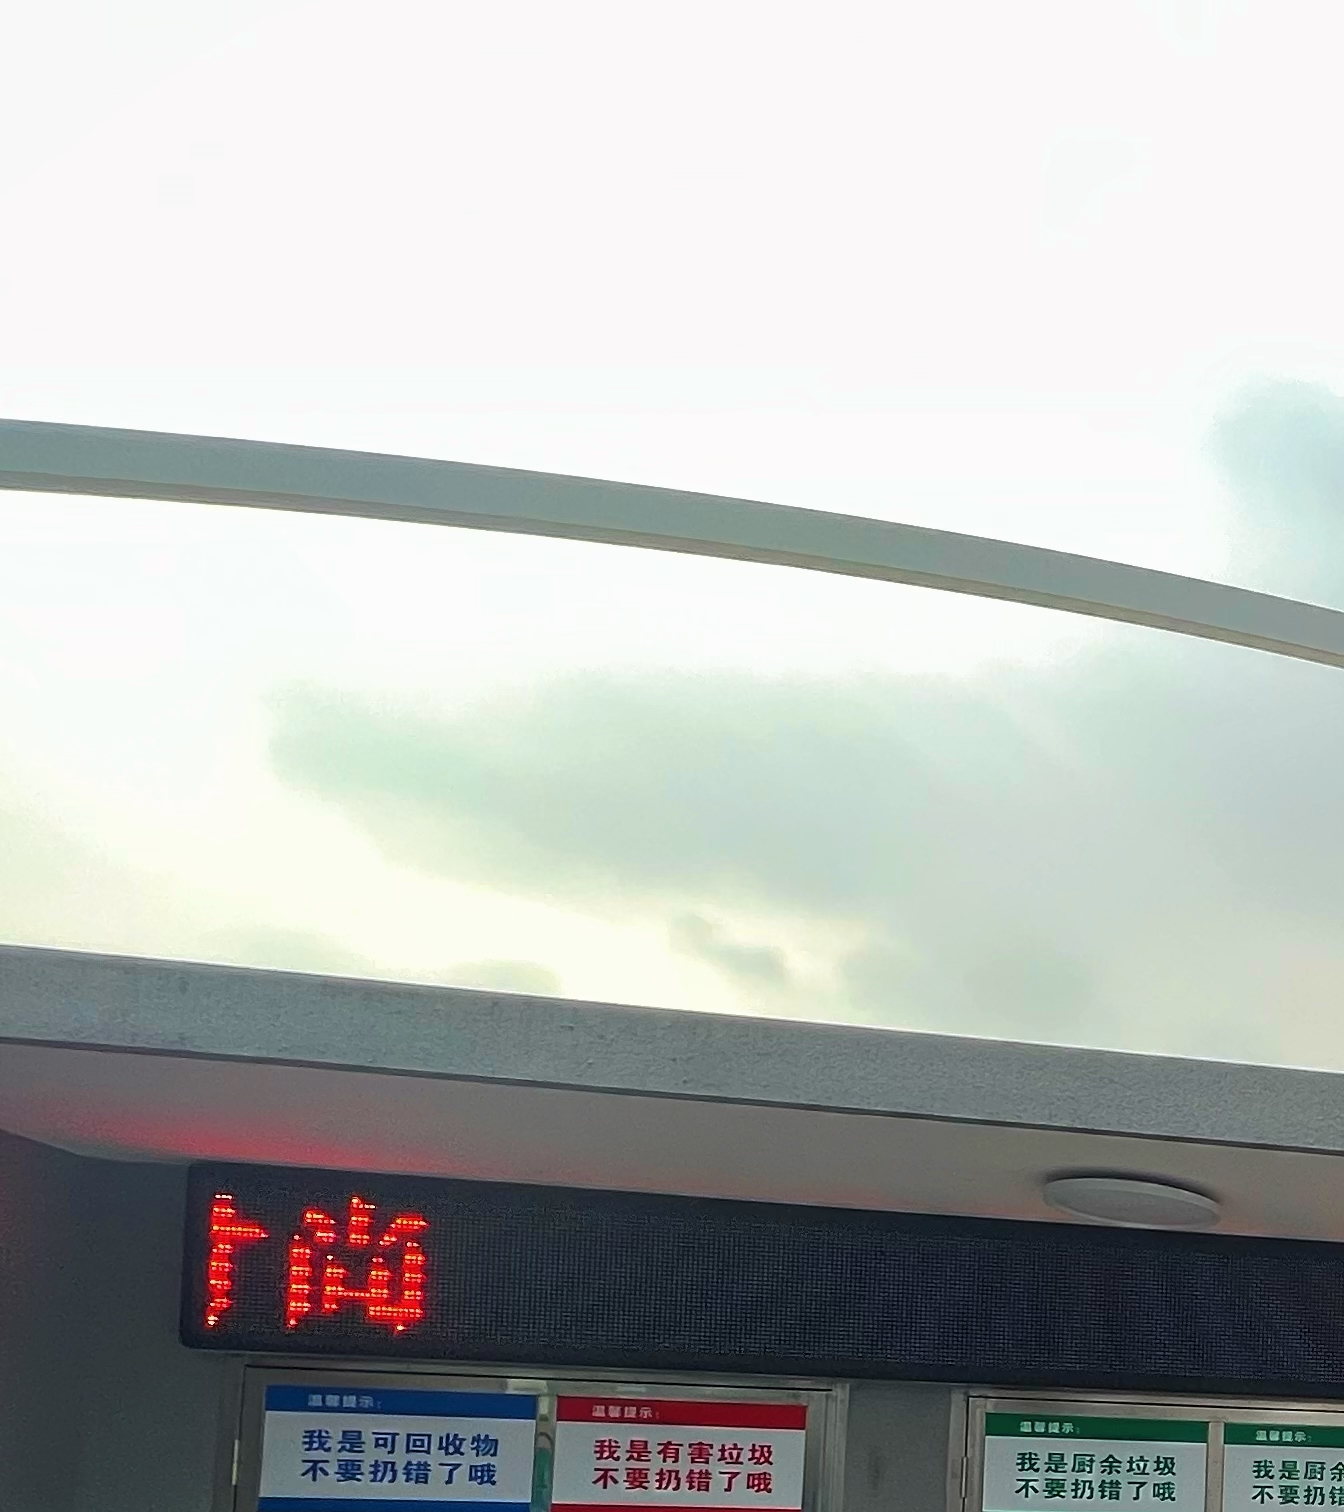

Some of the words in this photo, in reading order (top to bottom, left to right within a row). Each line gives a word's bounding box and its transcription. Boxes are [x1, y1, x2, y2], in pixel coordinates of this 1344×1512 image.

[302, 1429, 498, 1458] 我是可回收物
[594, 1439, 773, 1466] 我是有害垃圾
[301, 1459, 496, 1485] 不要扔错了哦
[1016, 1452, 1176, 1476] 我是厨余垃圾
[592, 1467, 773, 1493] 不要扔错了哦
[1015, 1478, 1175, 1501] 不要扔错了哦
